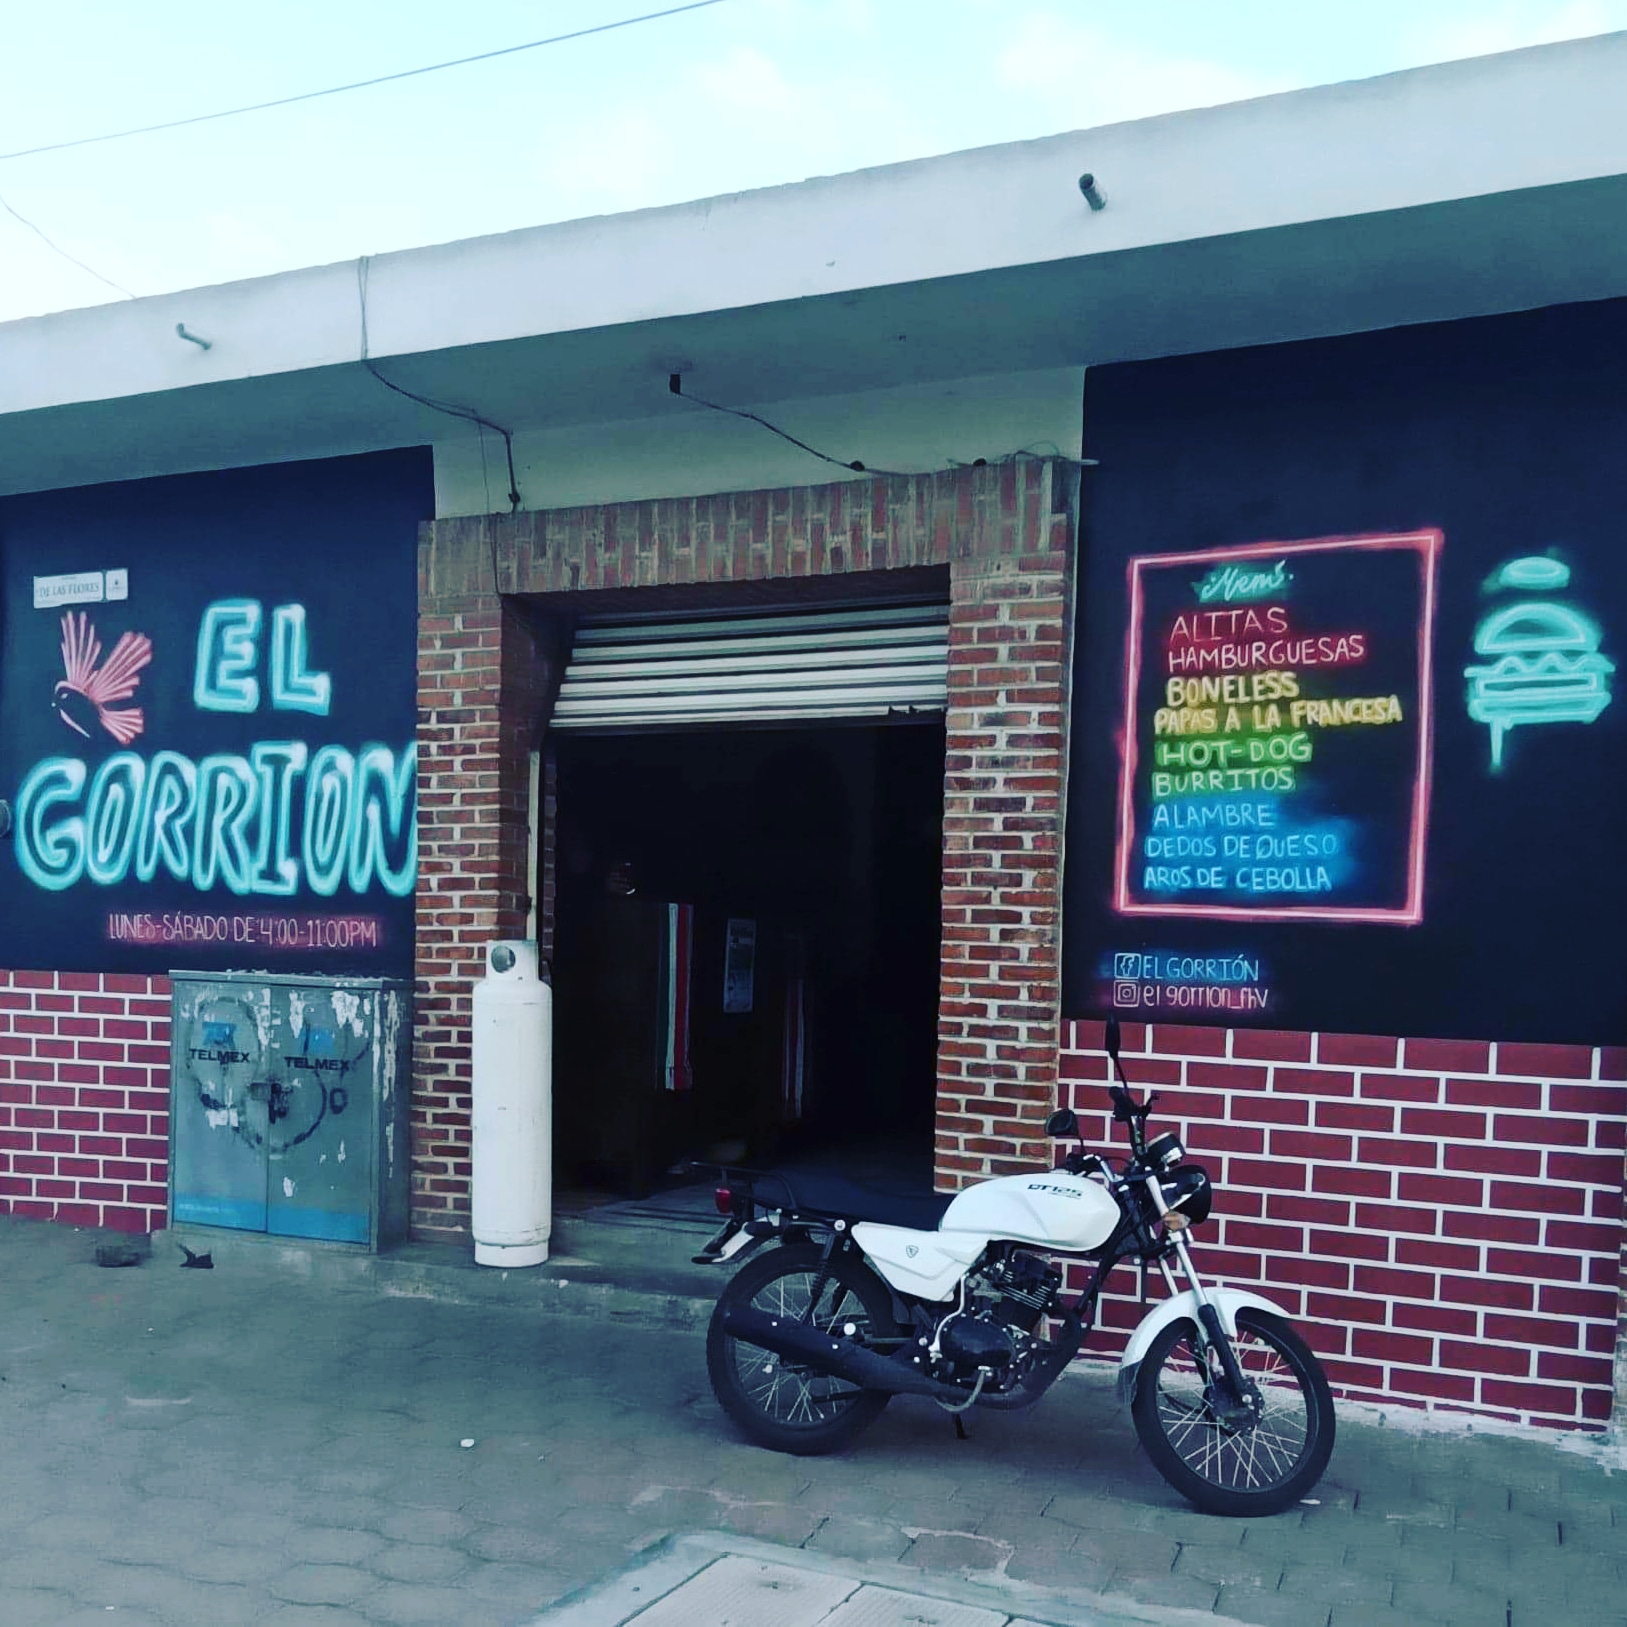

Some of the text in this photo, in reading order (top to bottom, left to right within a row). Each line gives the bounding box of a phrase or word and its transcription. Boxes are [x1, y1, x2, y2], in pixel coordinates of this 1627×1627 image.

[39, 582, 99, 597] DE LAS FLORES
[1170, 606, 1288, 641] ALITAS
[195, 599, 331, 715] EL
[1169, 634, 1364, 672] HAMBURGUESAS
[1167, 671, 1299, 707] BONELESS
[1154, 694, 1402, 734] PAPAS A LA FRANCESA
[1161, 733, 1312, 766] HOT-DOG
[1155, 767, 1294, 797] BURRITOS
[16, 740, 417, 896] GORRION
[1154, 803, 1275, 829] ALAMBRE
[1146, 834, 1338, 860] DEDOS DE QUESO
[1144, 866, 1332, 891] AROS DE CEBOLLA
[233, 916, 256, 943] DE
[1143, 953, 1259, 981] EL GORRIÓN
[188, 1048, 250, 1063] TELMEX
[284, 1056, 350, 1071] TELMEX
